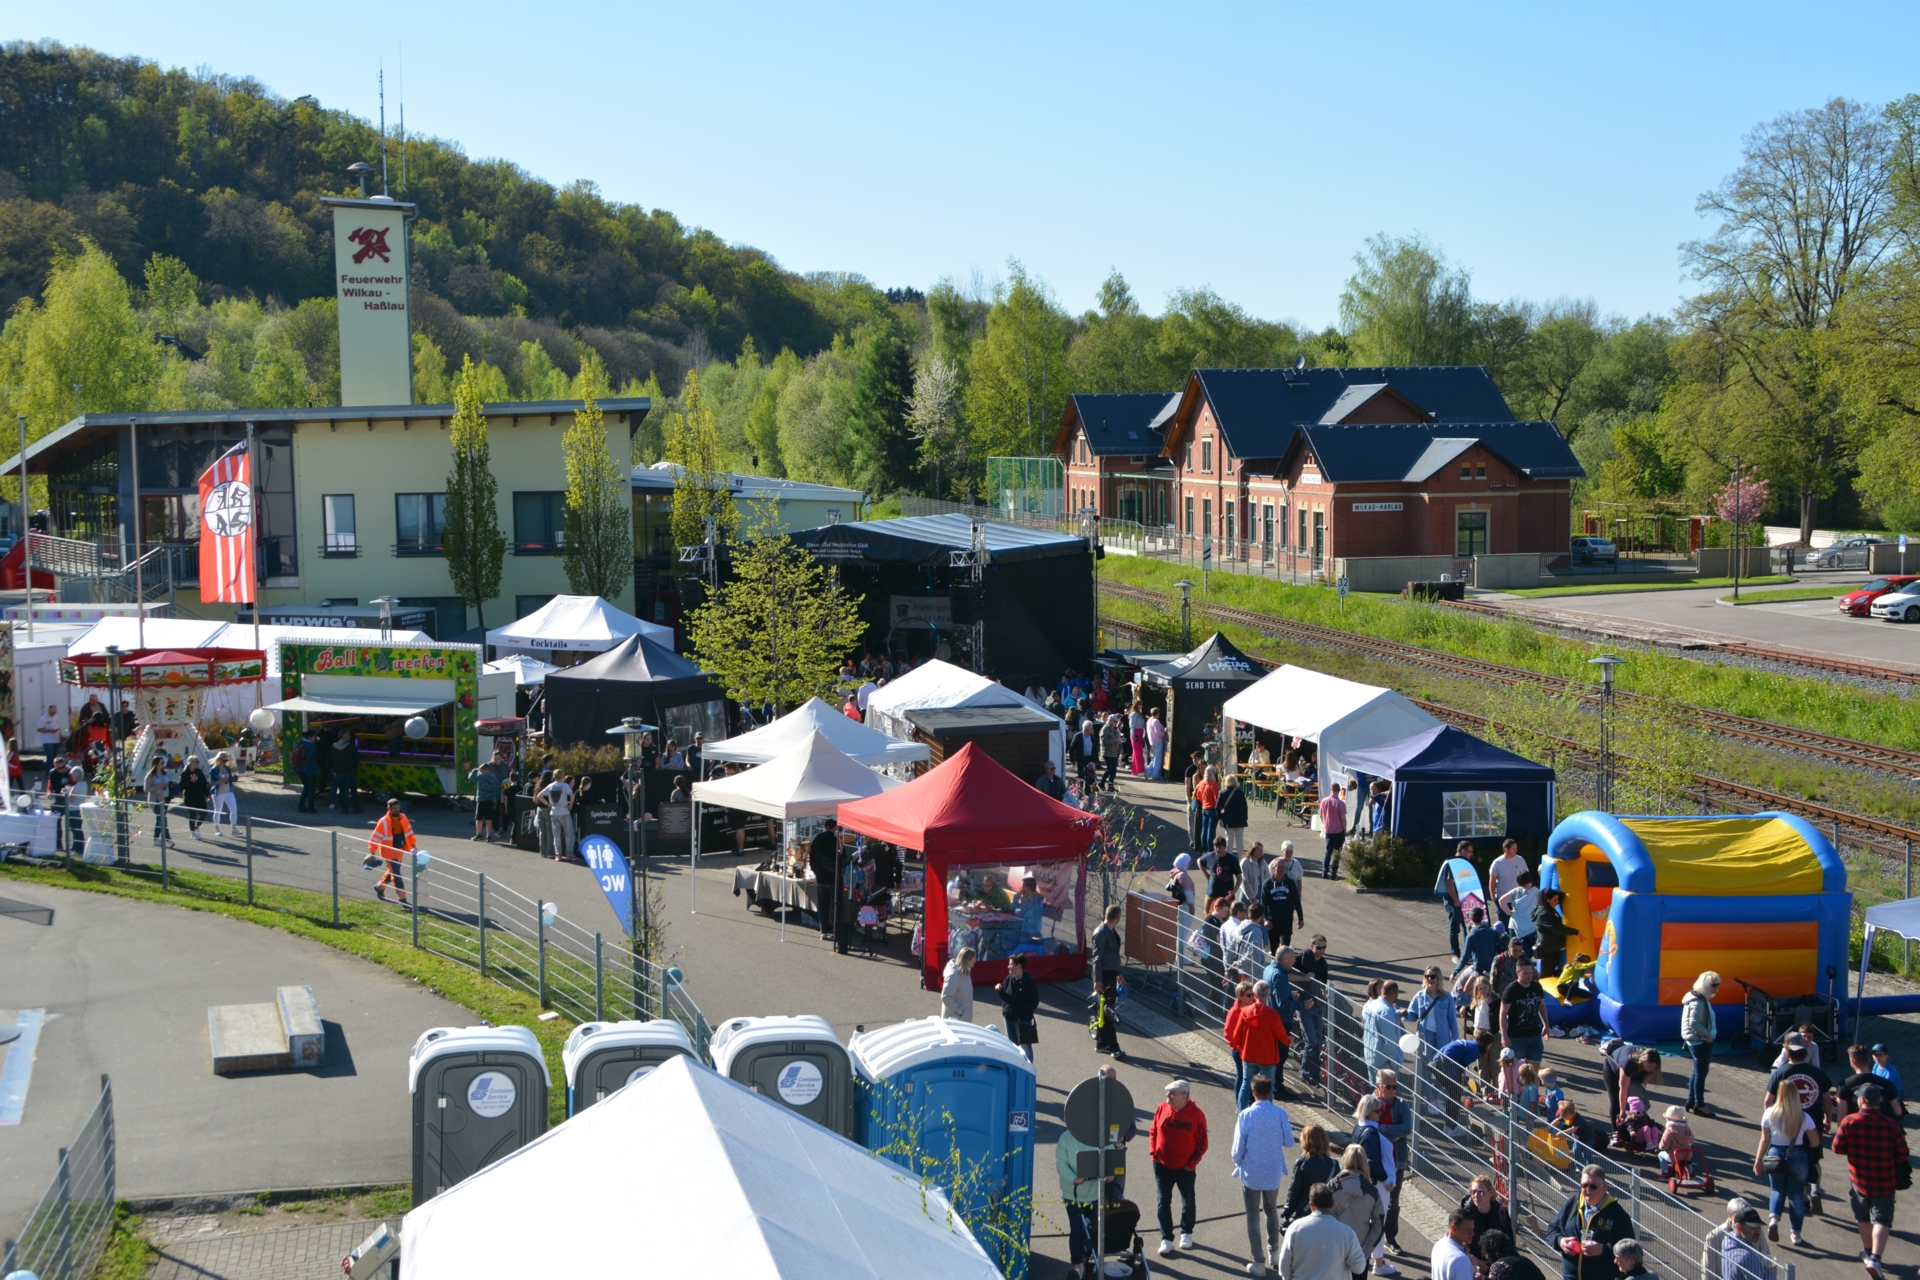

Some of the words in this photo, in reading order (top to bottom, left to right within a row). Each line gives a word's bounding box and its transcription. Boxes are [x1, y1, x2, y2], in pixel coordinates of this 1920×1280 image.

[342, 275, 403, 284] Feuerwehr
[343, 288, 382, 297] Wilkau
[364, 302, 404, 310] Haßlau
[914, 604, 951, 613] Frühlingsfe
[531, 639, 568, 648] Cocktails
[314, 647, 357, 672] Ball
[392, 654, 446, 670] werfen
